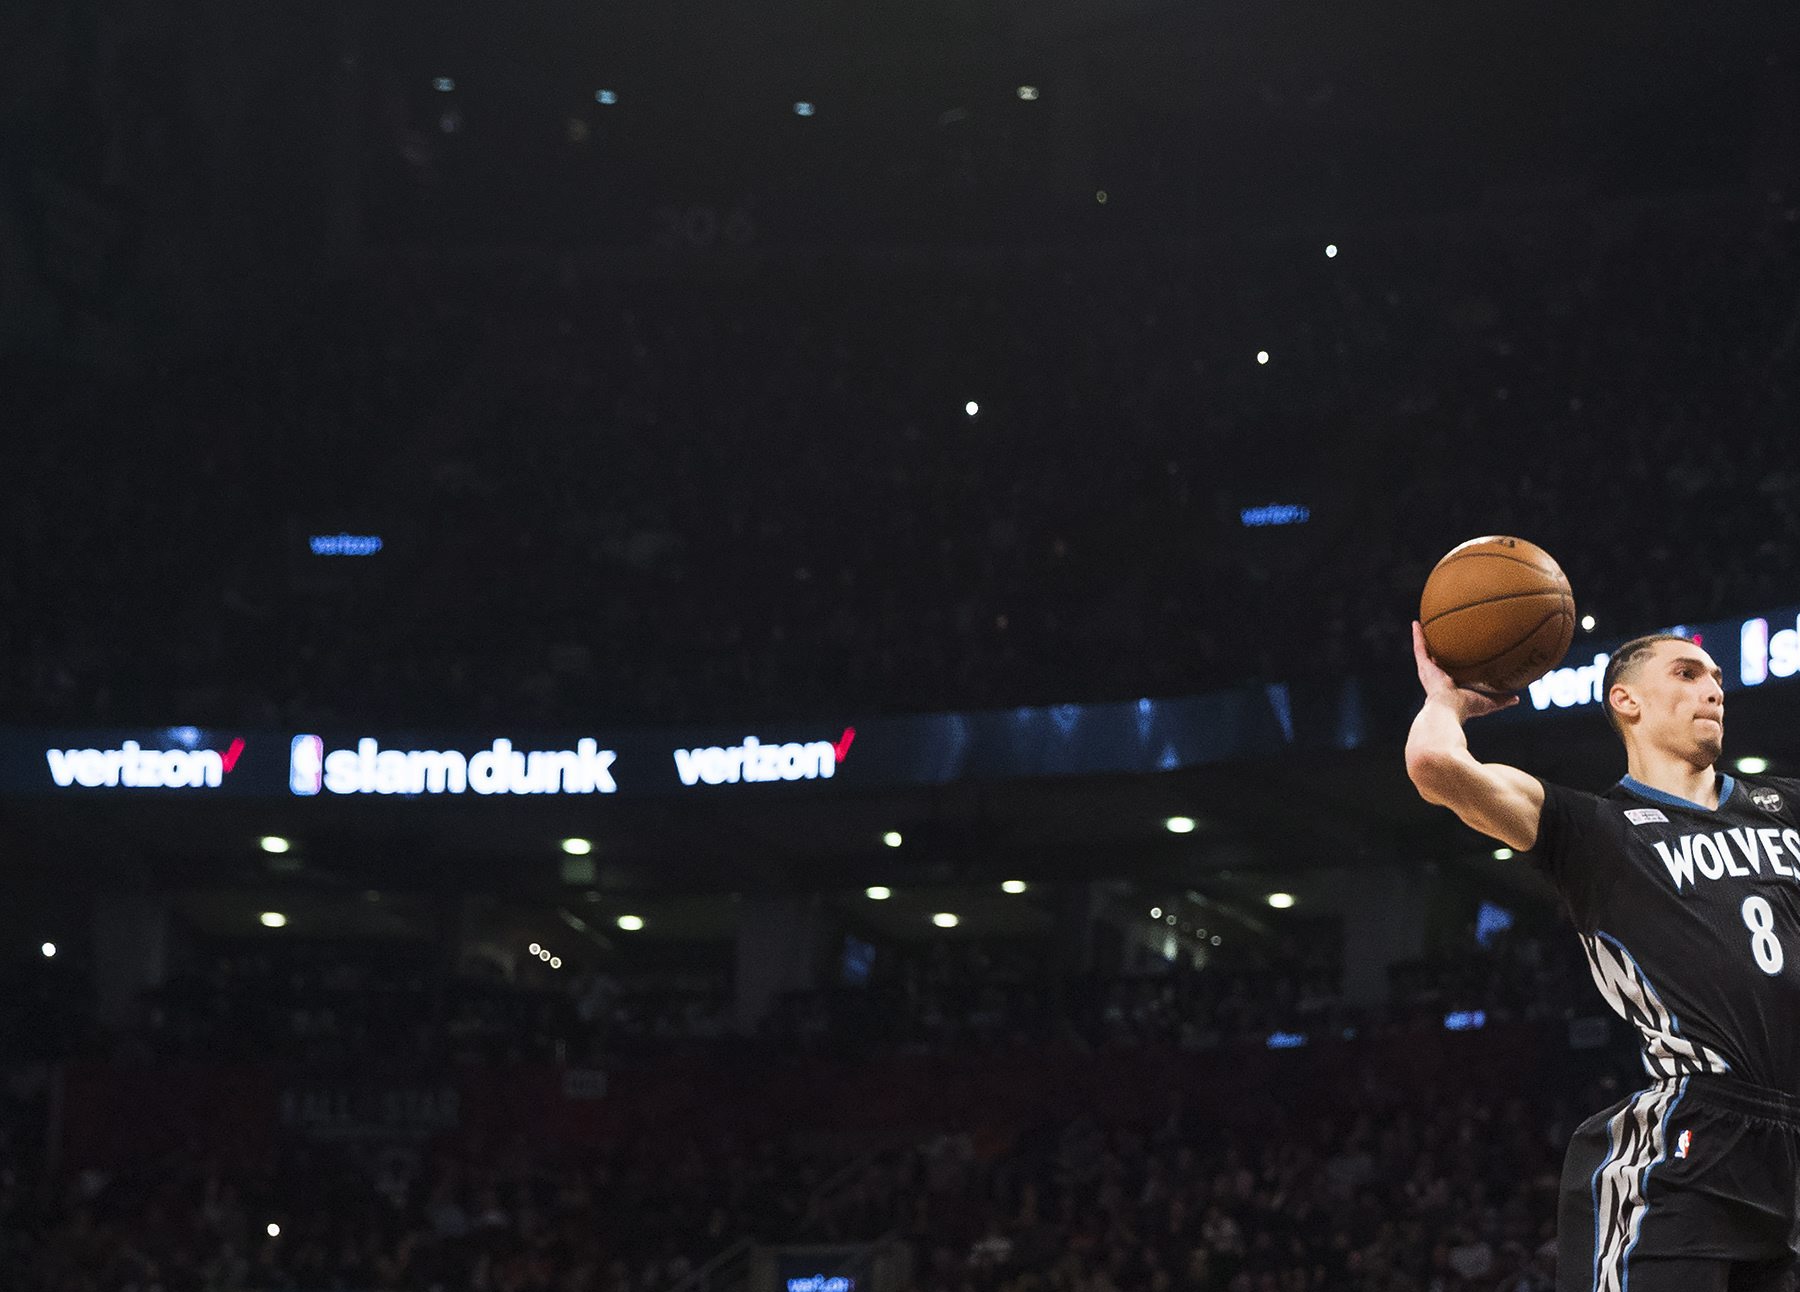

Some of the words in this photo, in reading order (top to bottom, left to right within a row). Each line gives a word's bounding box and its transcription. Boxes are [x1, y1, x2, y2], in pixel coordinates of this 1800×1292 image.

[1529, 653, 1609, 710] veri
[46, 740, 223, 788] verizon
[673, 736, 836, 786] verizon
[1741, 895, 1784, 975] 8
